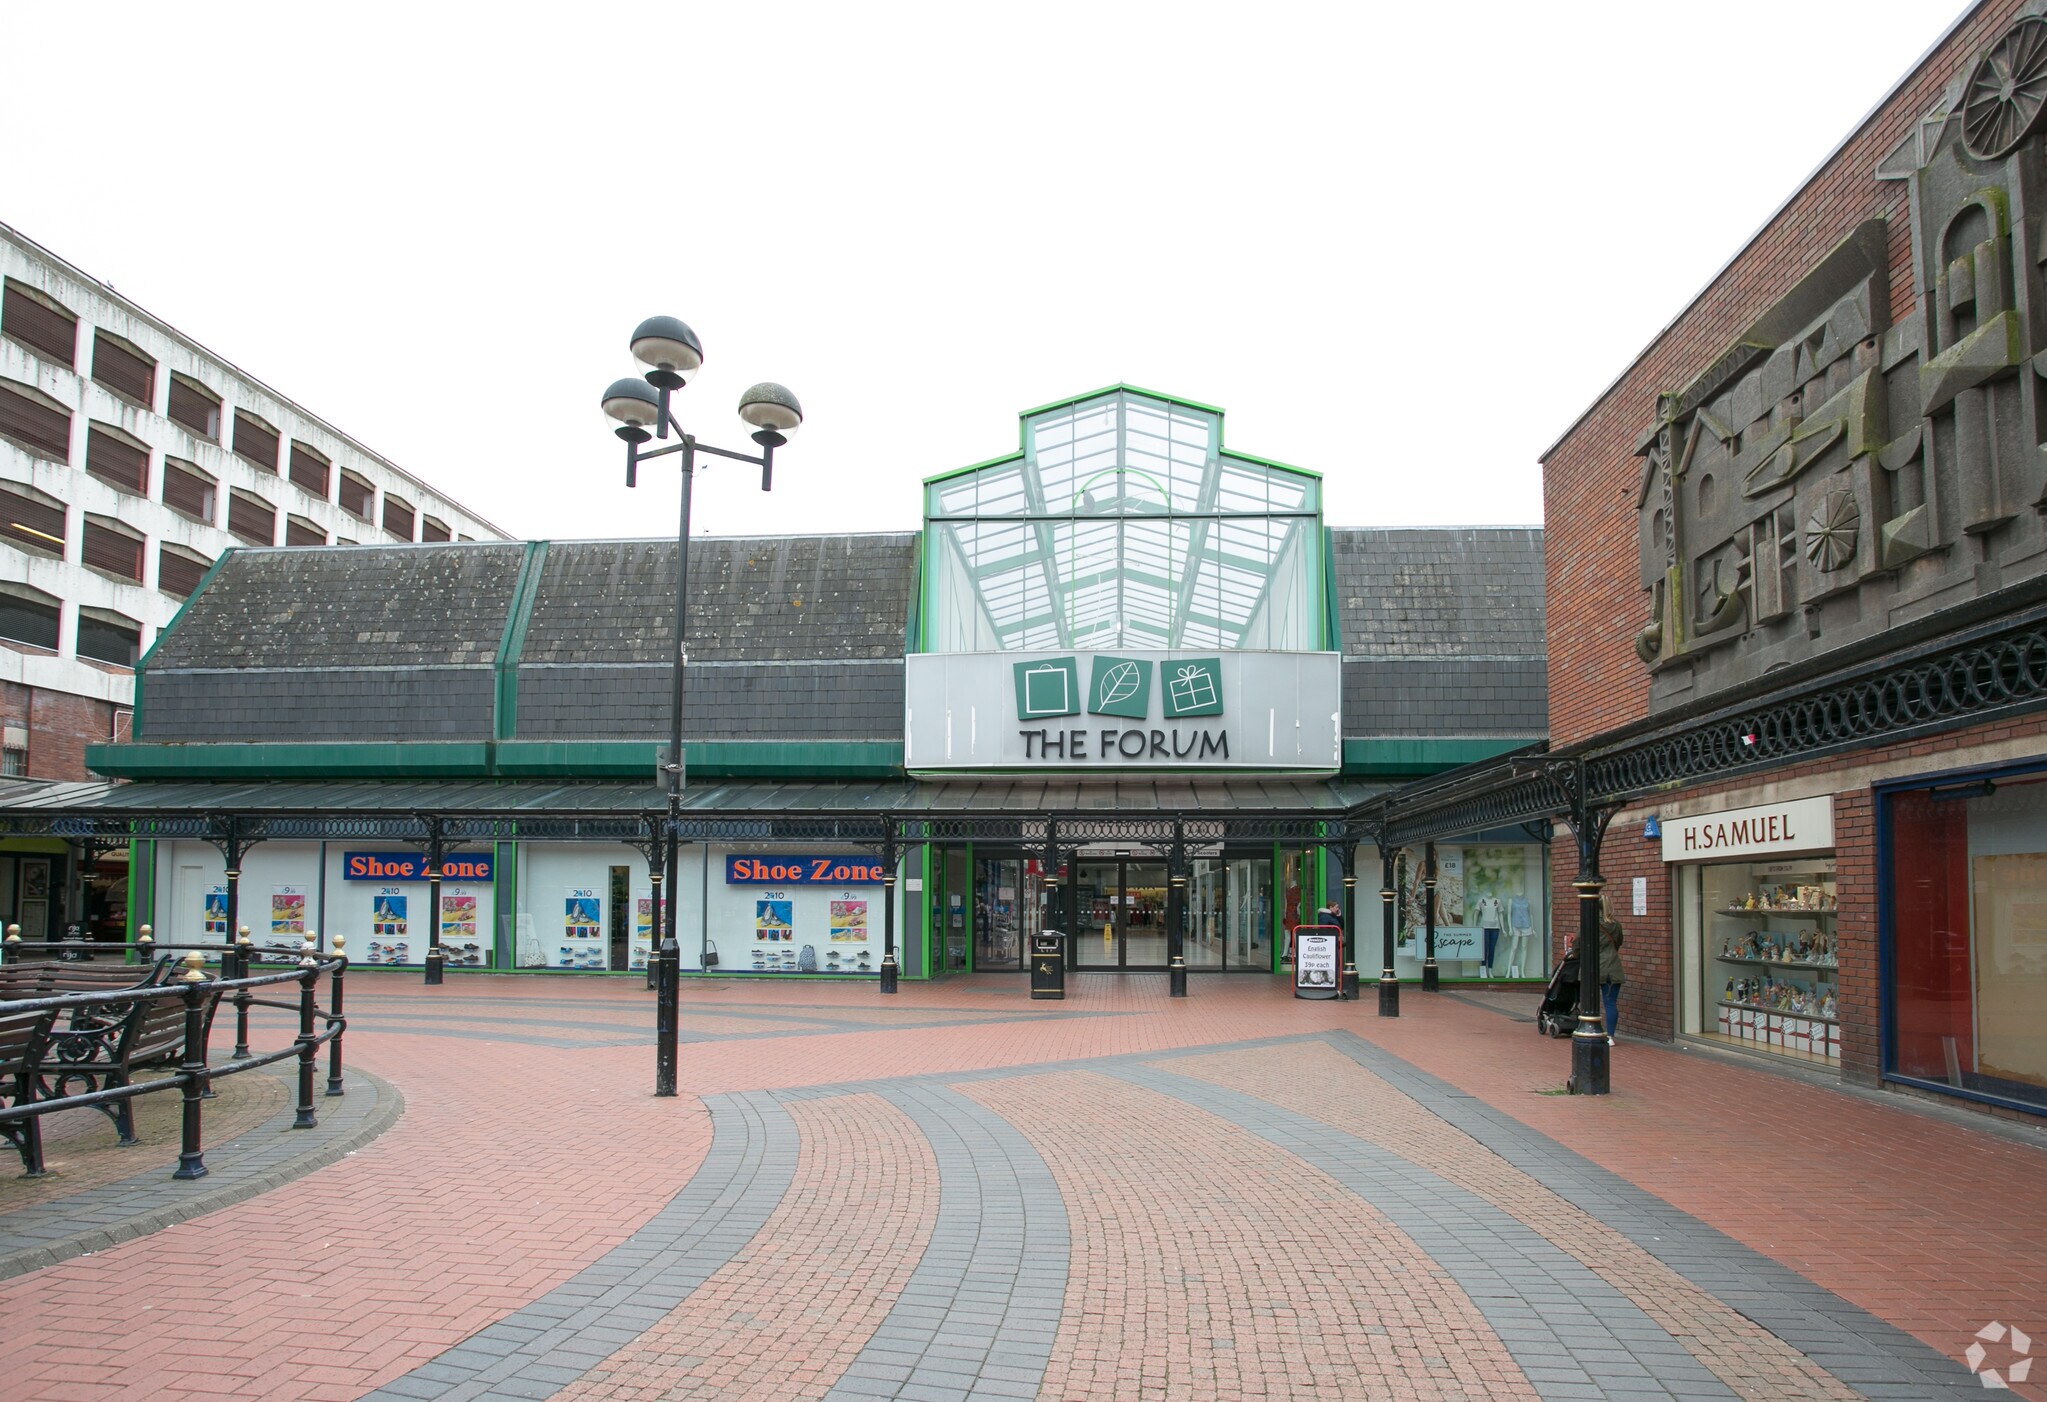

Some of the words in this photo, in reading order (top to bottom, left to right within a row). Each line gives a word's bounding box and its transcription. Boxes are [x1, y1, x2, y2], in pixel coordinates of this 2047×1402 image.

[1019, 728, 1087, 758] THE
[1101, 729, 1229, 758] FORUM
[1684, 814, 1796, 851] H.SAMUEL
[350, 856, 414, 876] Shoe
[733, 859, 803, 880] Shoe
[810, 859, 884, 880] Zone
